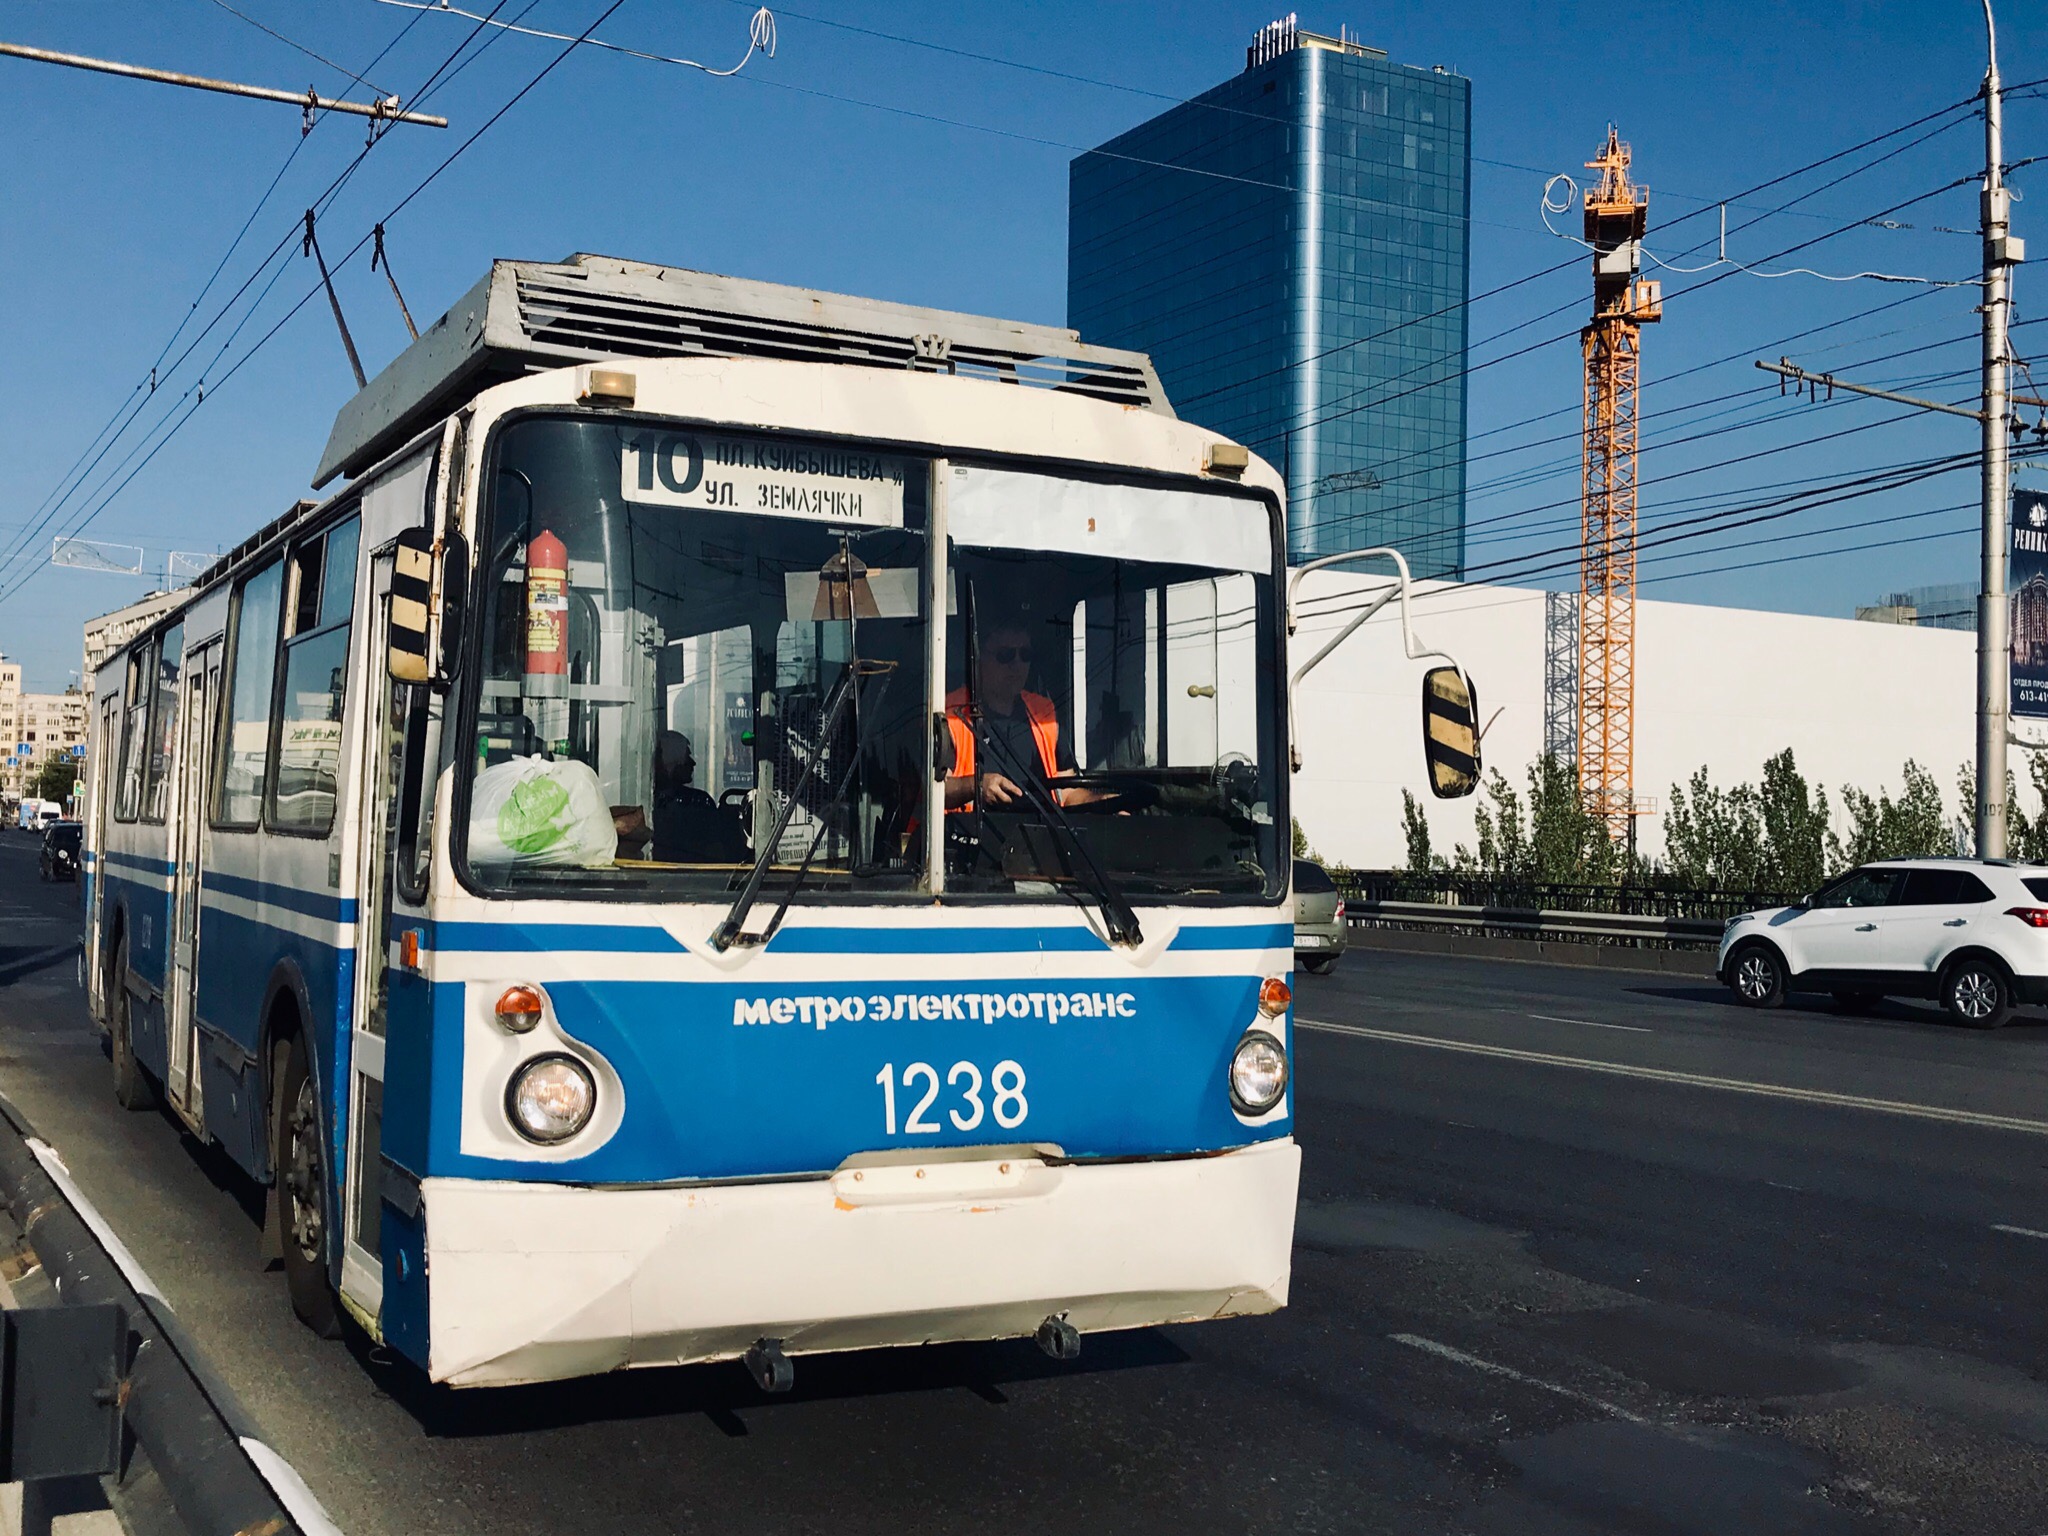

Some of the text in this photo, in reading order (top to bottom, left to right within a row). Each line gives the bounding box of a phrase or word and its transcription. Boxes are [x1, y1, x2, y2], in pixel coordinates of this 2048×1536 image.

[629, 432, 704, 494] 10
[705, 480, 862, 518] УЛ. ЗЕМЛЯЧКИ
[2020, 690, 2048, 703] 613-41
[733, 992, 1136, 1030] метроэлектротранс
[875, 1060, 1028, 1135] 1238
